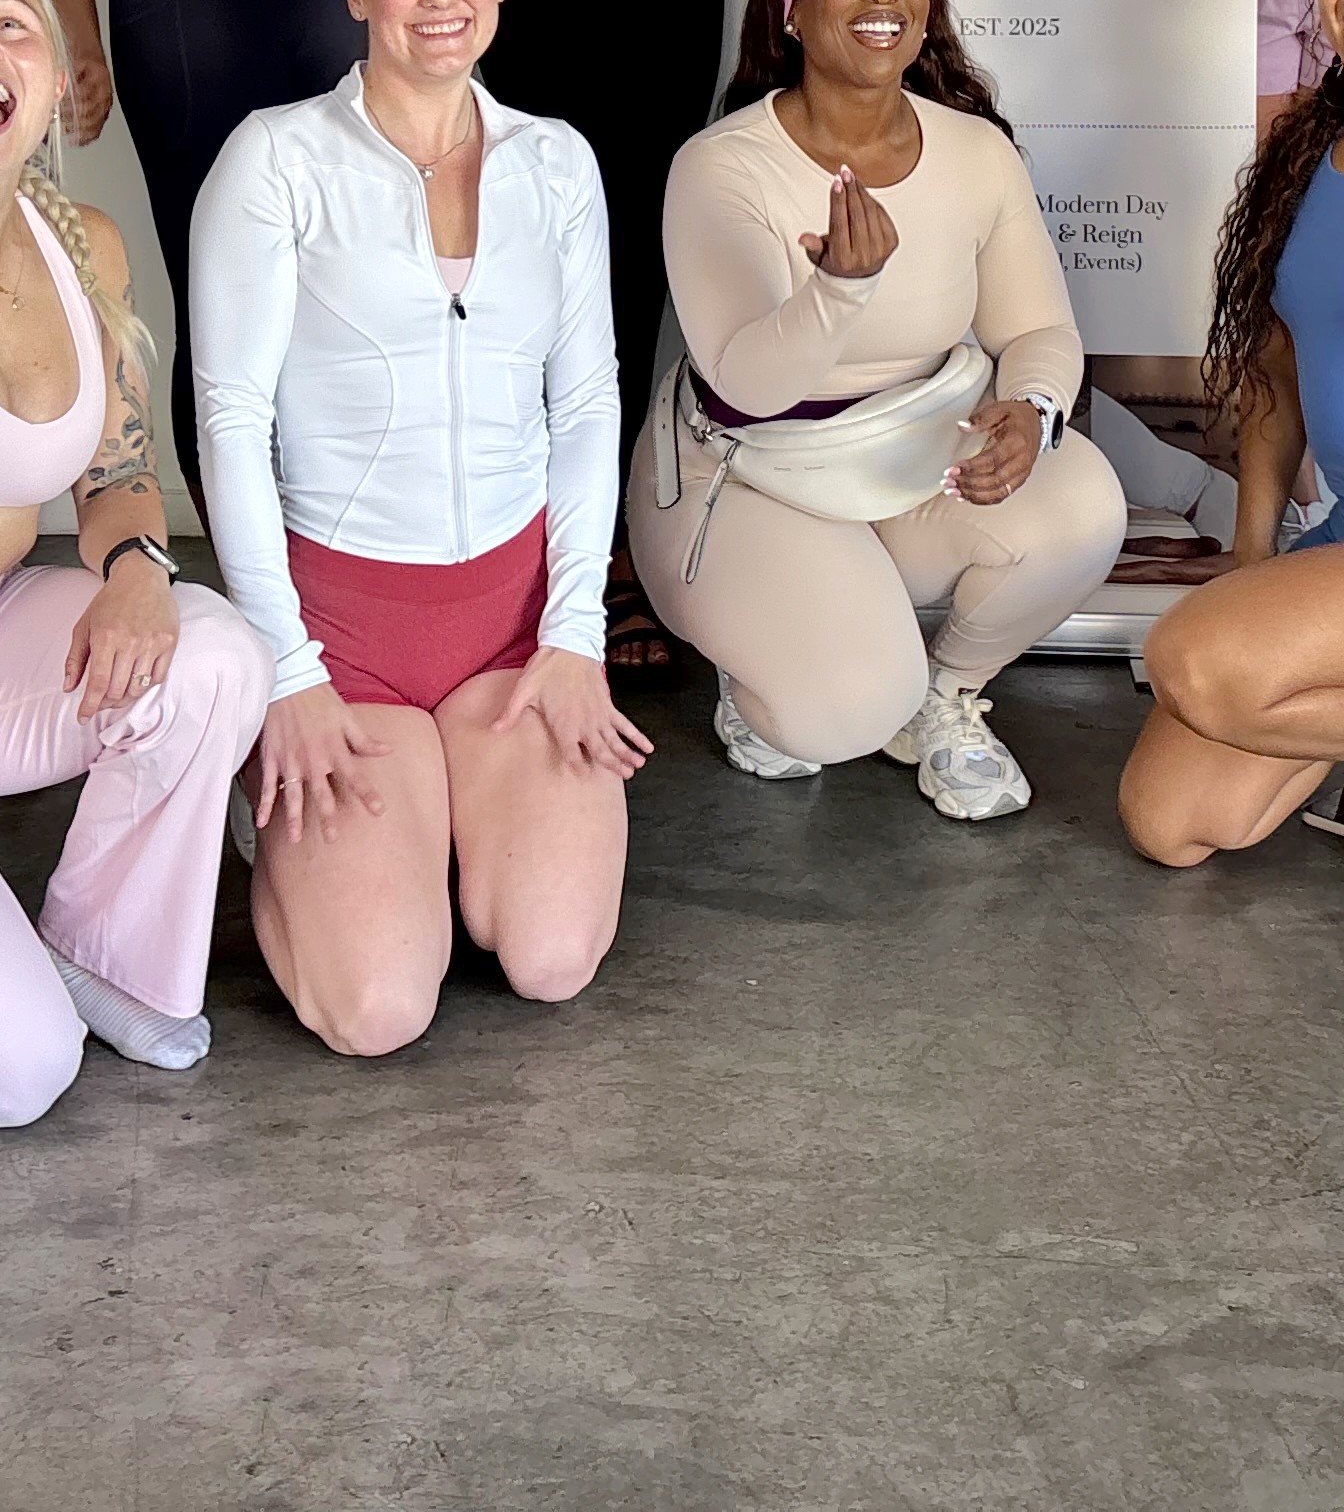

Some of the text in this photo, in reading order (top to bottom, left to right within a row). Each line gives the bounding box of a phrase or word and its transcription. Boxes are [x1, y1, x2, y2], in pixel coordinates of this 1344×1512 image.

[959, 17, 1061, 37] EST. 2025
[1036, 193, 1168, 221] Modern Day
[1058, 223, 1142, 249] & Reign
[1073, 251, 1142, 274] Events)
